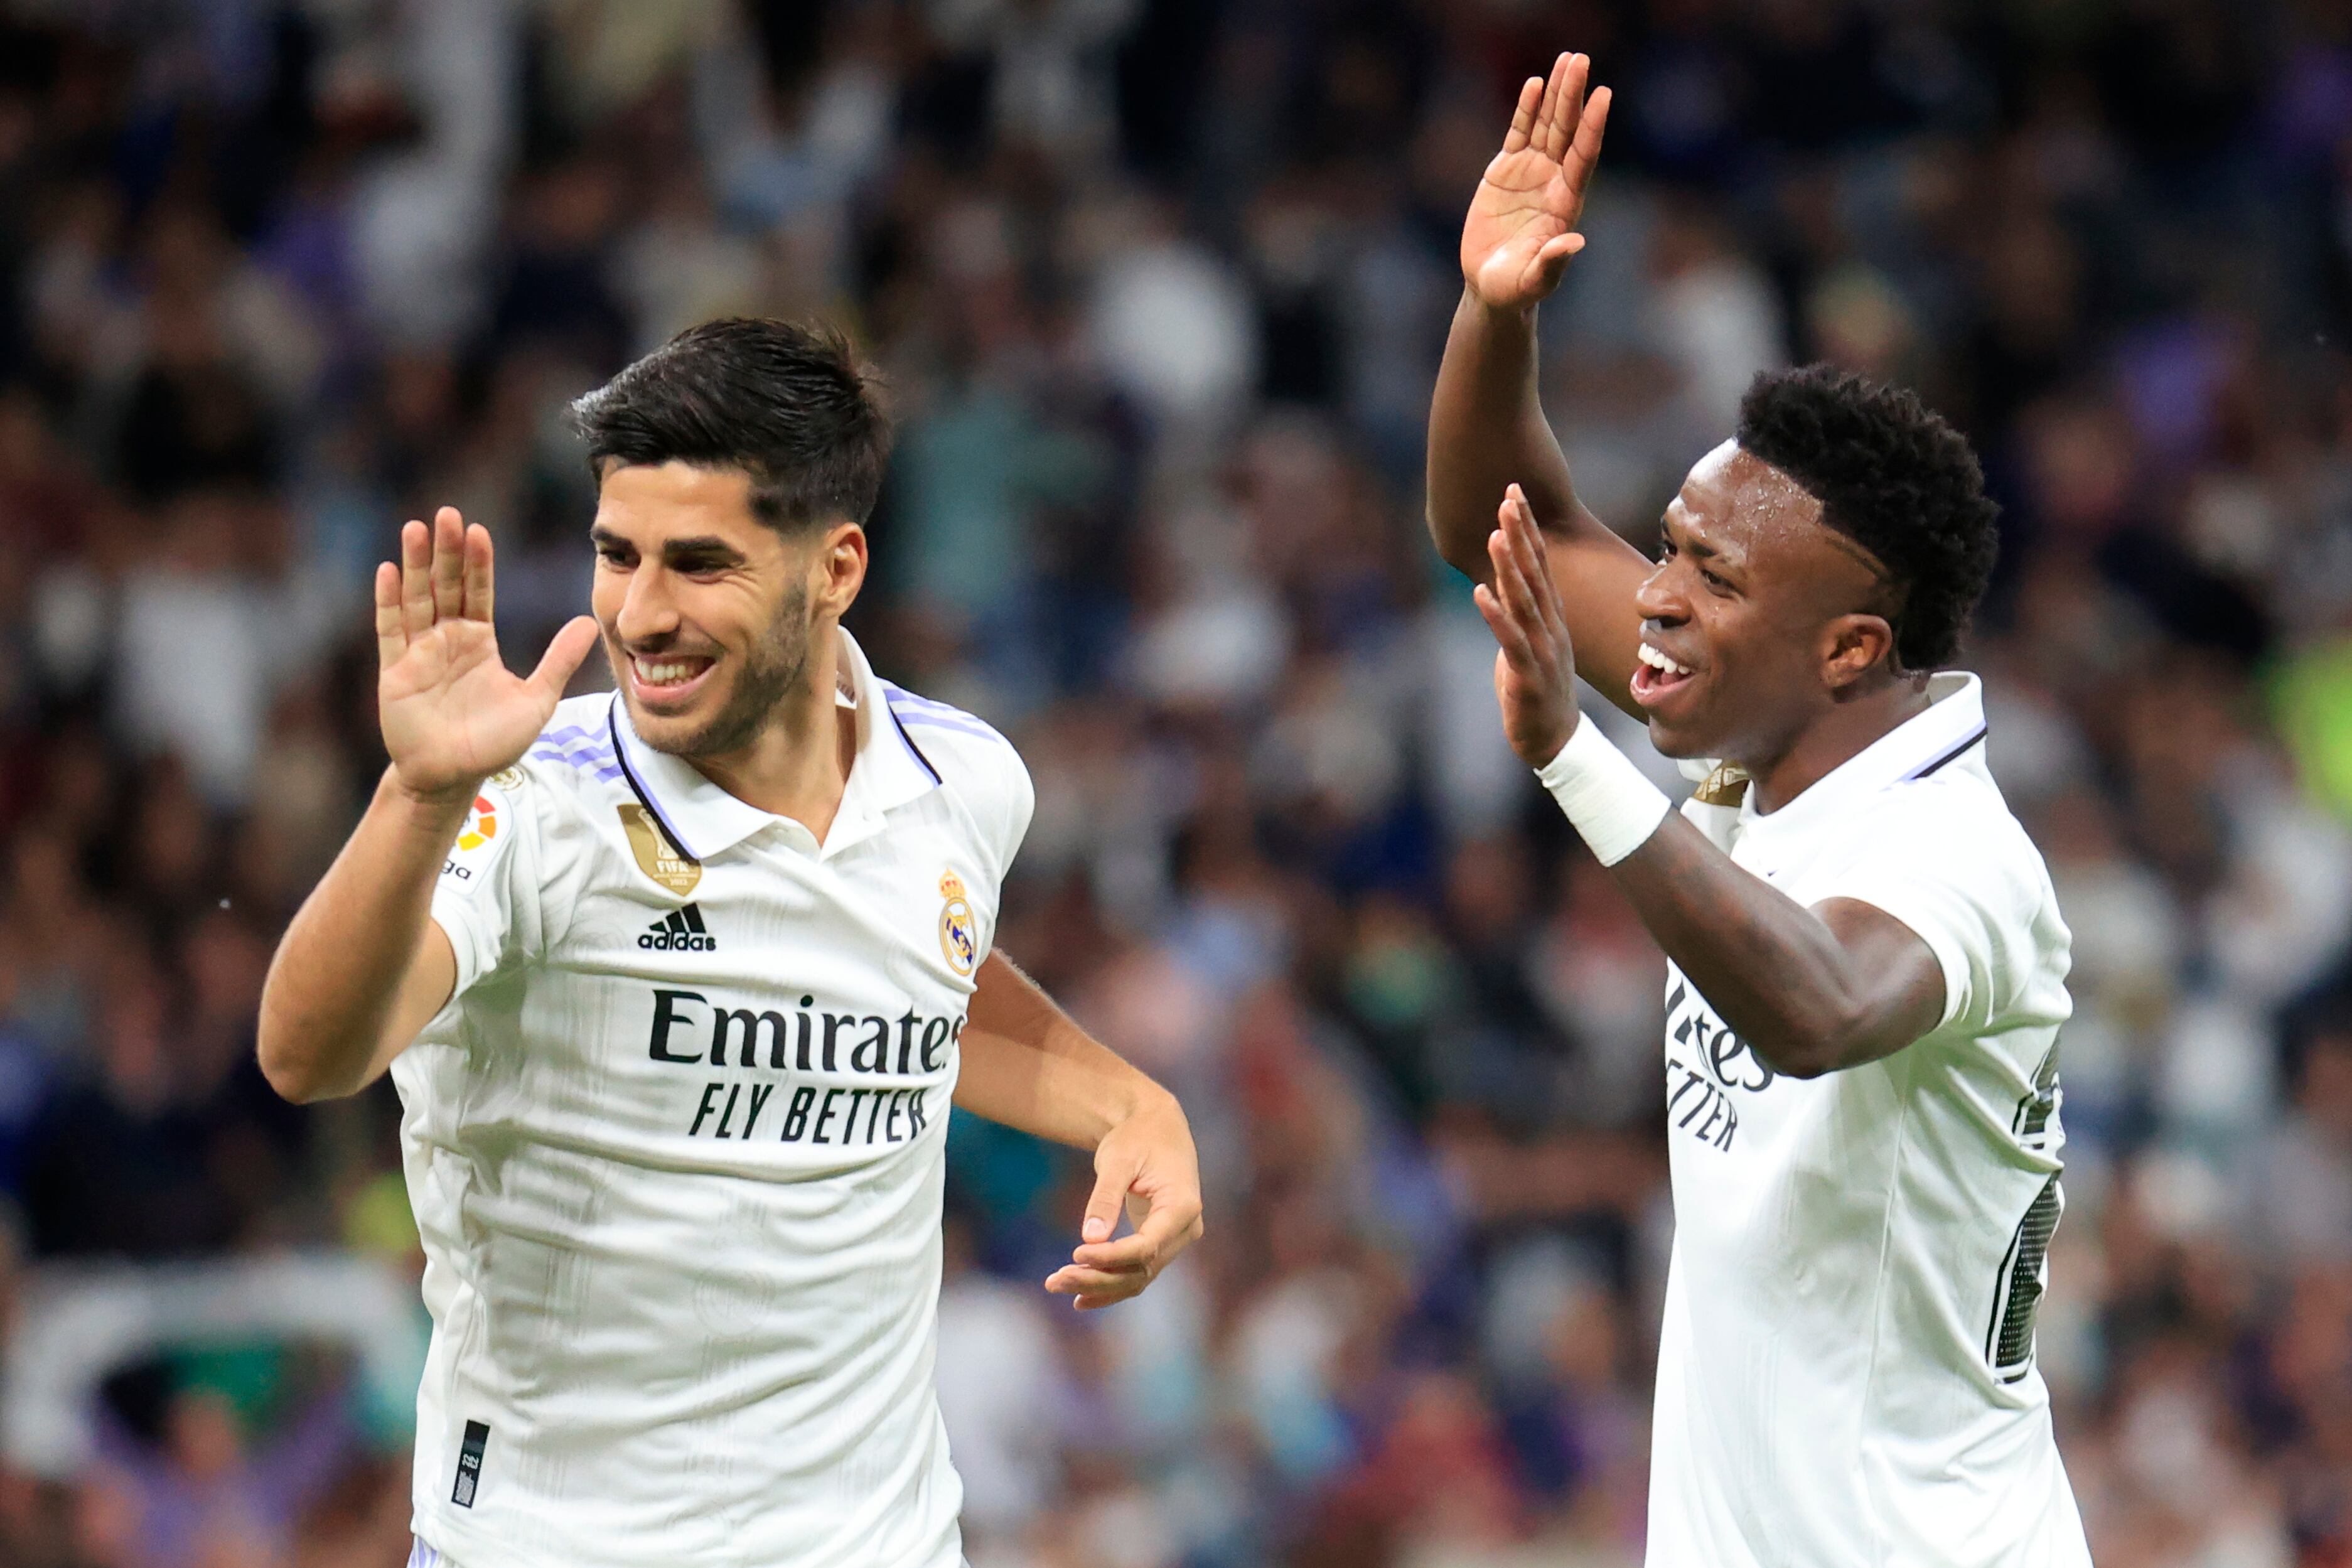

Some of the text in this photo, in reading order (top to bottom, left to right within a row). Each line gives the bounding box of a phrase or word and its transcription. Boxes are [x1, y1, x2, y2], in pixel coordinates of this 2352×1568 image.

[657, 860, 690, 873] FIFA
[638, 932, 716, 951] adidas
[688, 1083, 928, 1145] FLY BETTER
[1666, 1058, 1738, 1152] TTER
